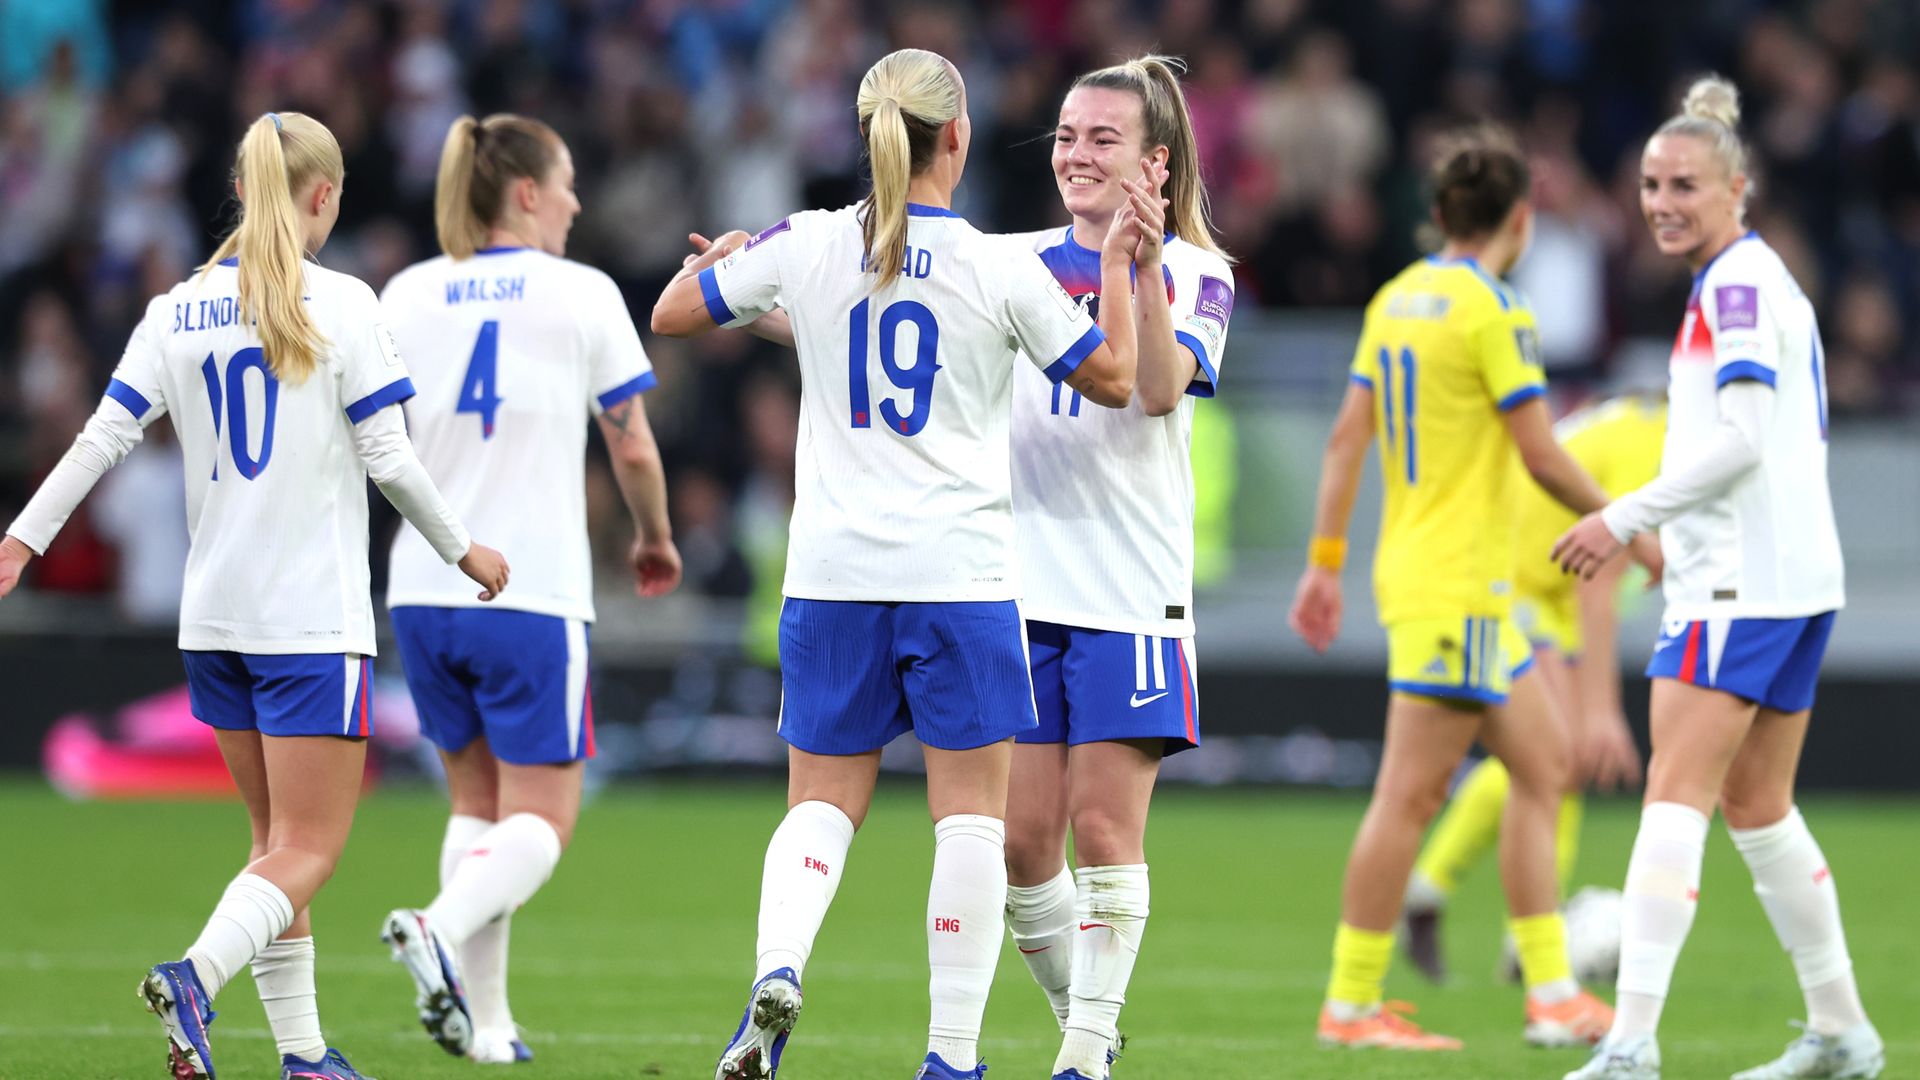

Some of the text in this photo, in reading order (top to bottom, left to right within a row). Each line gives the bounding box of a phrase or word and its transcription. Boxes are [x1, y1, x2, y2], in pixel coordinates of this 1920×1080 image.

[446, 275, 525, 304] WALSH
[456, 320, 504, 441] 4
[849, 296, 943, 437] 19
[202, 347, 279, 482] 10
[1380, 348, 1416, 484] 11
[1135, 634, 1166, 691] 11
[805, 856, 829, 876] ENG
[935, 918, 960, 933] ENG
